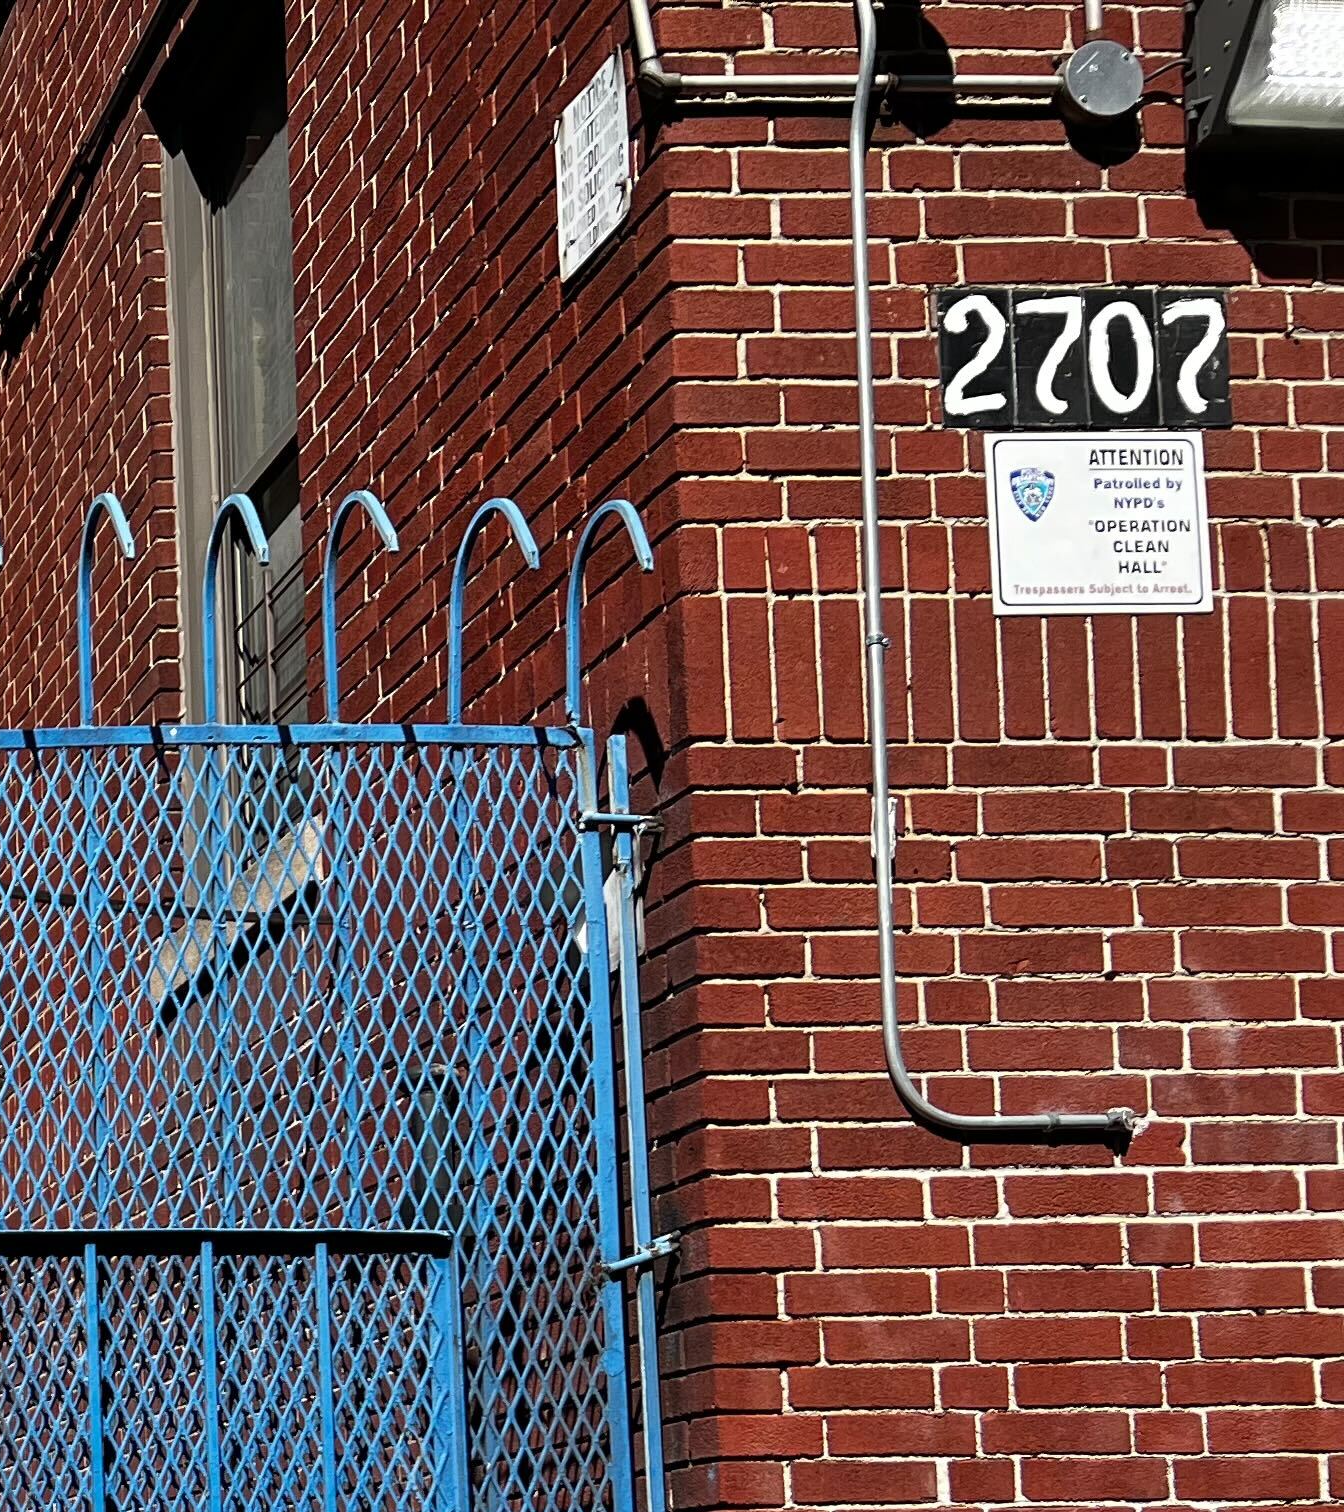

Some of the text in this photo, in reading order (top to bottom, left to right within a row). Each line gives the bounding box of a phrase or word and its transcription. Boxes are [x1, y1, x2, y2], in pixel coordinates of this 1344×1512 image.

[573, 68, 608, 130] NOTICE
[560, 143, 573, 174] NO
[561, 171, 574, 201] NO
[562, 198, 575, 229] NO
[943, 294, 1226, 416] 2707
[1089, 448, 1184, 467] ATTENTION
[1093, 477, 1183, 492] Patrolled by
[1113, 496, 1166, 510] NYPD's
[1088, 519, 1191, 534] "OPERATION
[1113, 540, 1170, 554] CLEAN
[1118, 560, 1168, 574] HALL"
[1013, 583, 1193, 597] Trespassers Subject to Arrest.
